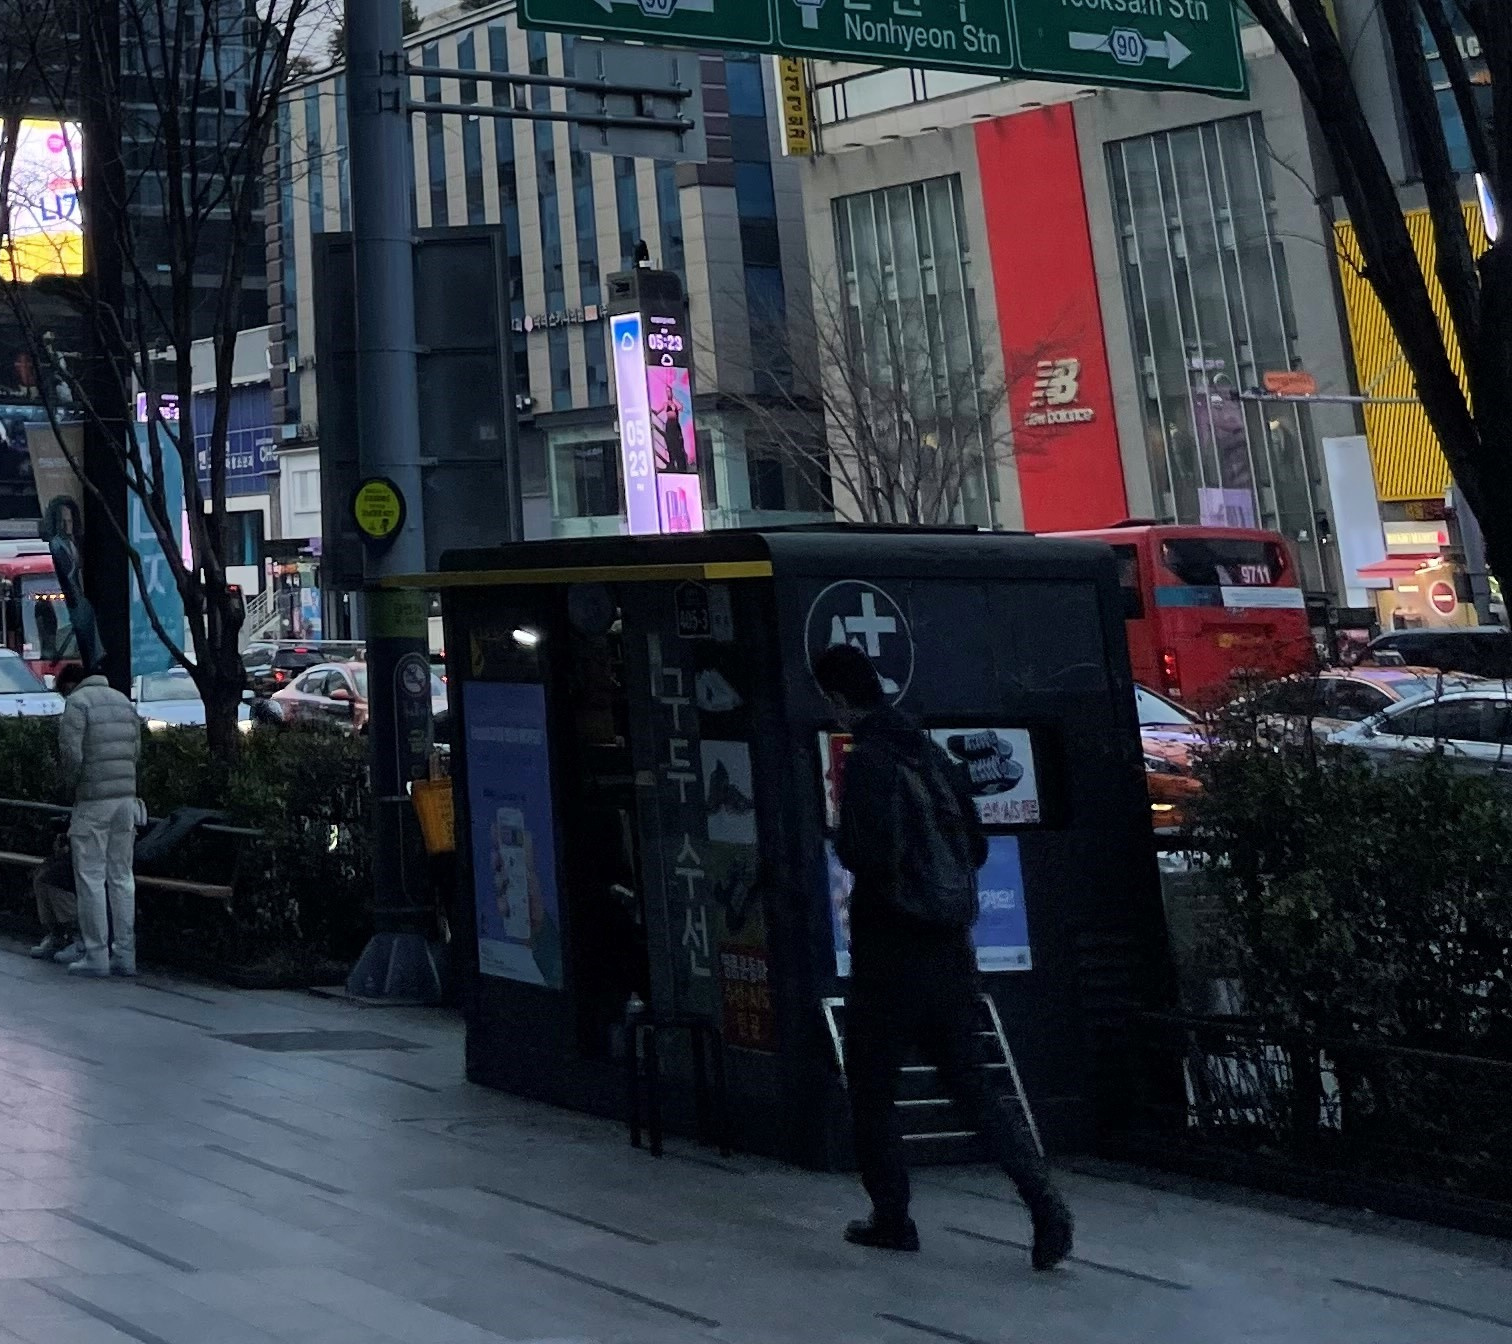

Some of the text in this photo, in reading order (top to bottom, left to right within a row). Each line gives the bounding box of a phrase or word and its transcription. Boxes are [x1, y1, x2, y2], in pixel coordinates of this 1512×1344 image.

[844, 13, 1001, 54] Nonhyeon Stn
[1116, 34, 1138, 58] 90
[648, 333, 683, 351] 05:23
[1241, 565, 1271, 584] 9711
